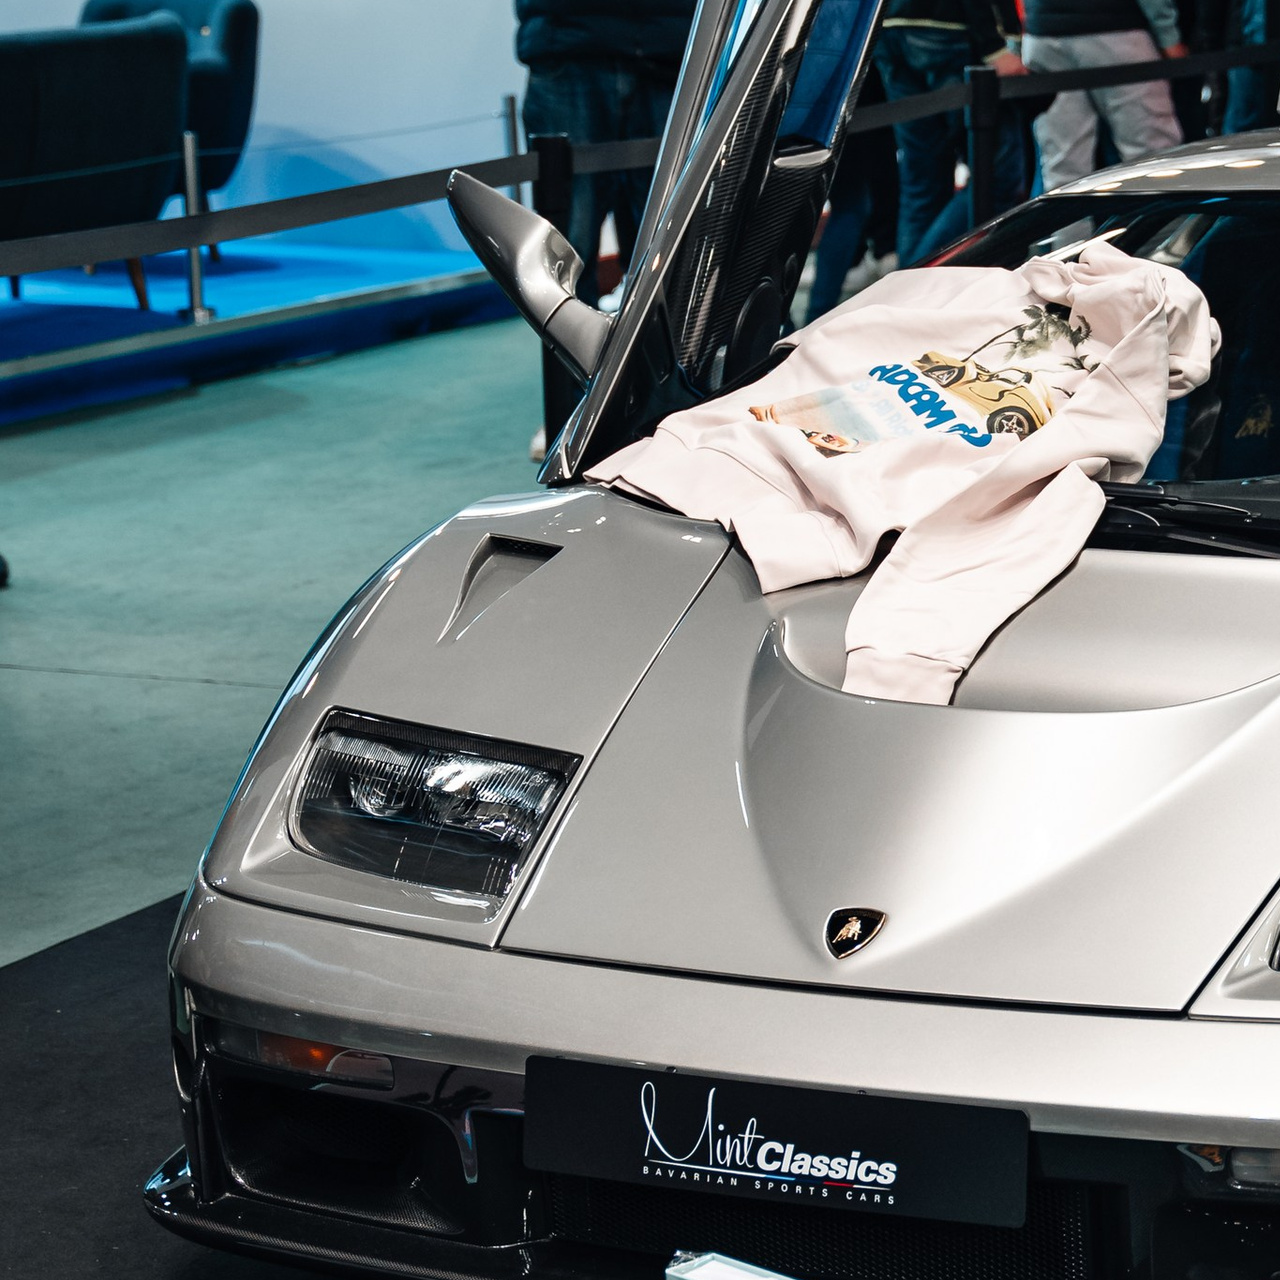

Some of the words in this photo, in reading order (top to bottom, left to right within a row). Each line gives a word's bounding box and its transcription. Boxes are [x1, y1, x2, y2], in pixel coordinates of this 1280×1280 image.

[642, 1166, 738, 1187] BAVARIAN
[754, 1180, 829, 1198] SPORTS
[845, 1191, 895, 1205] CARS
